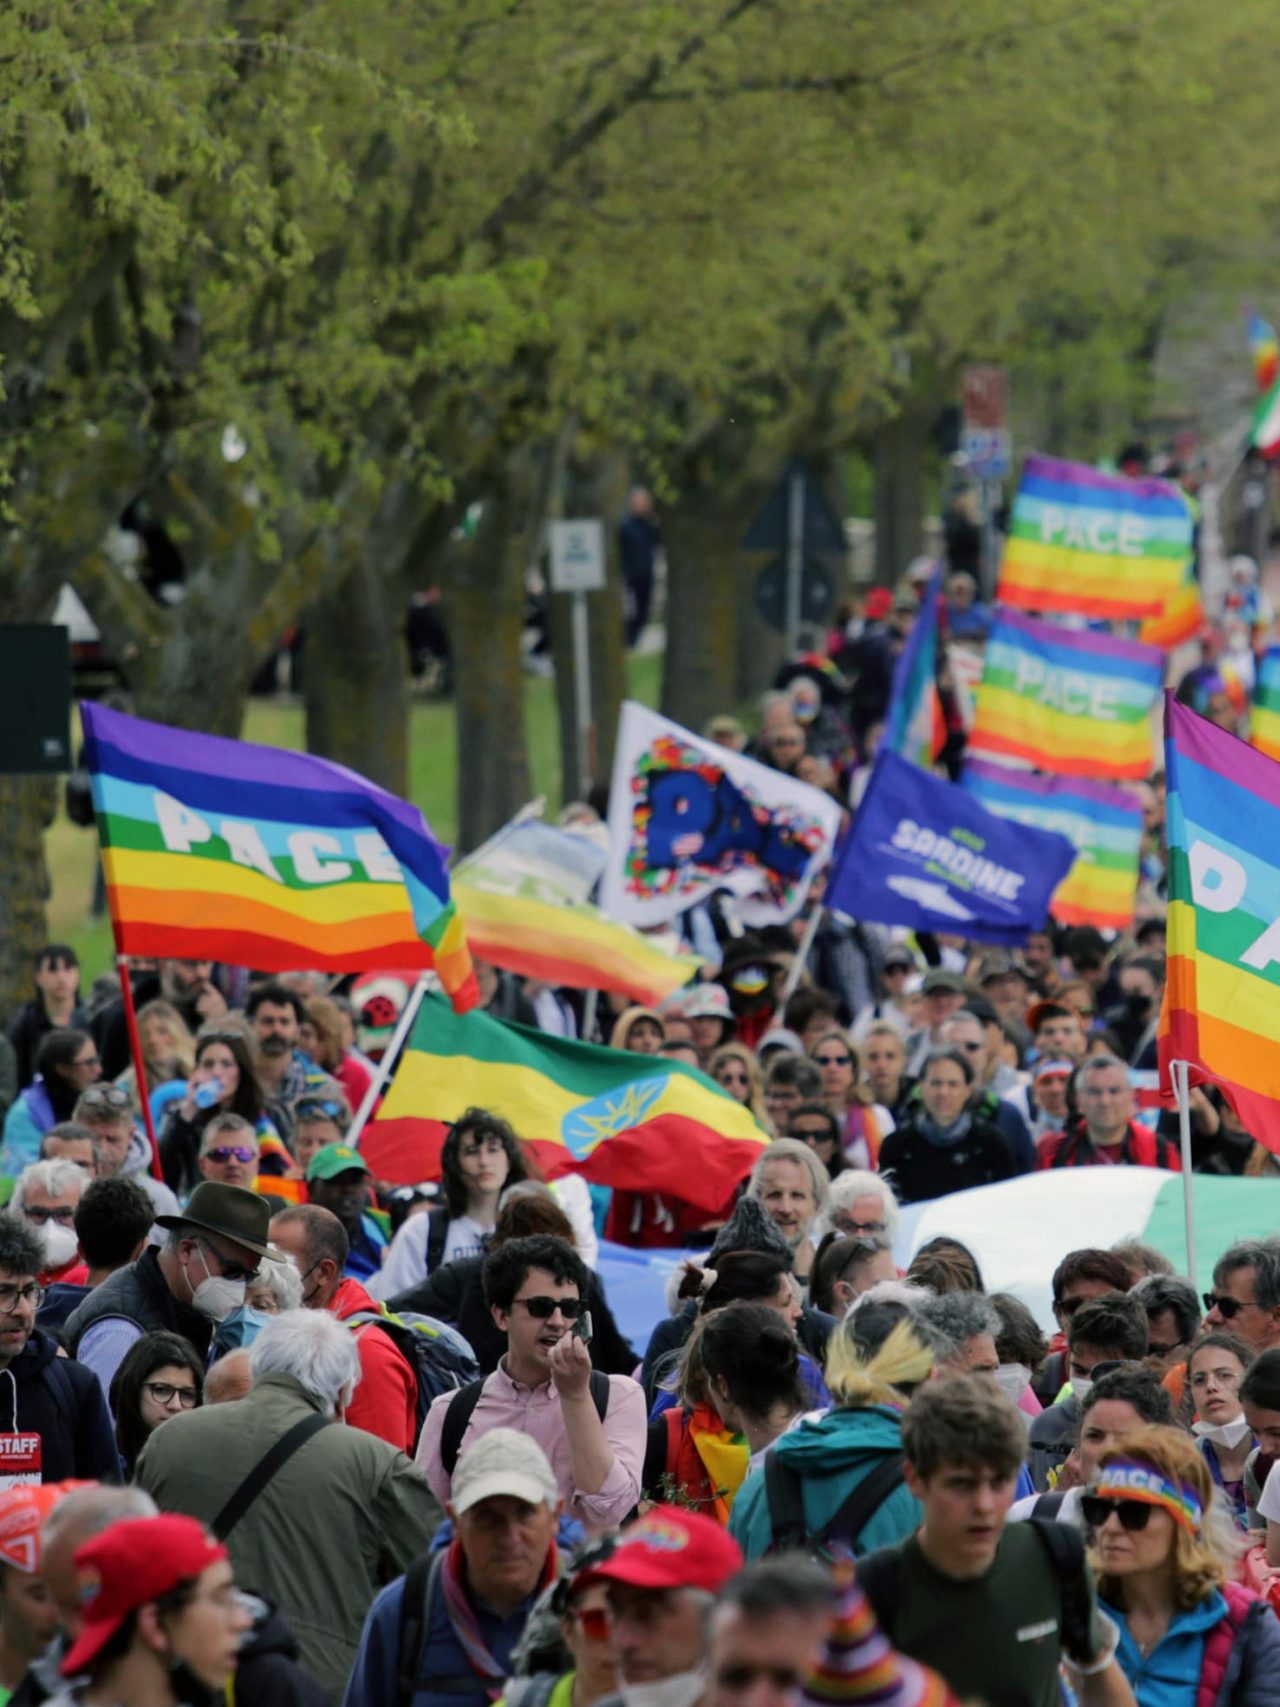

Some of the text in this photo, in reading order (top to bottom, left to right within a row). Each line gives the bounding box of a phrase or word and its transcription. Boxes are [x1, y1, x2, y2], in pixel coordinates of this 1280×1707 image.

[1037, 505, 1149, 557] PACE
[1013, 654, 1125, 720] PACE
[152, 790, 405, 884] PACE
[889, 817, 1026, 901] SARDINE
